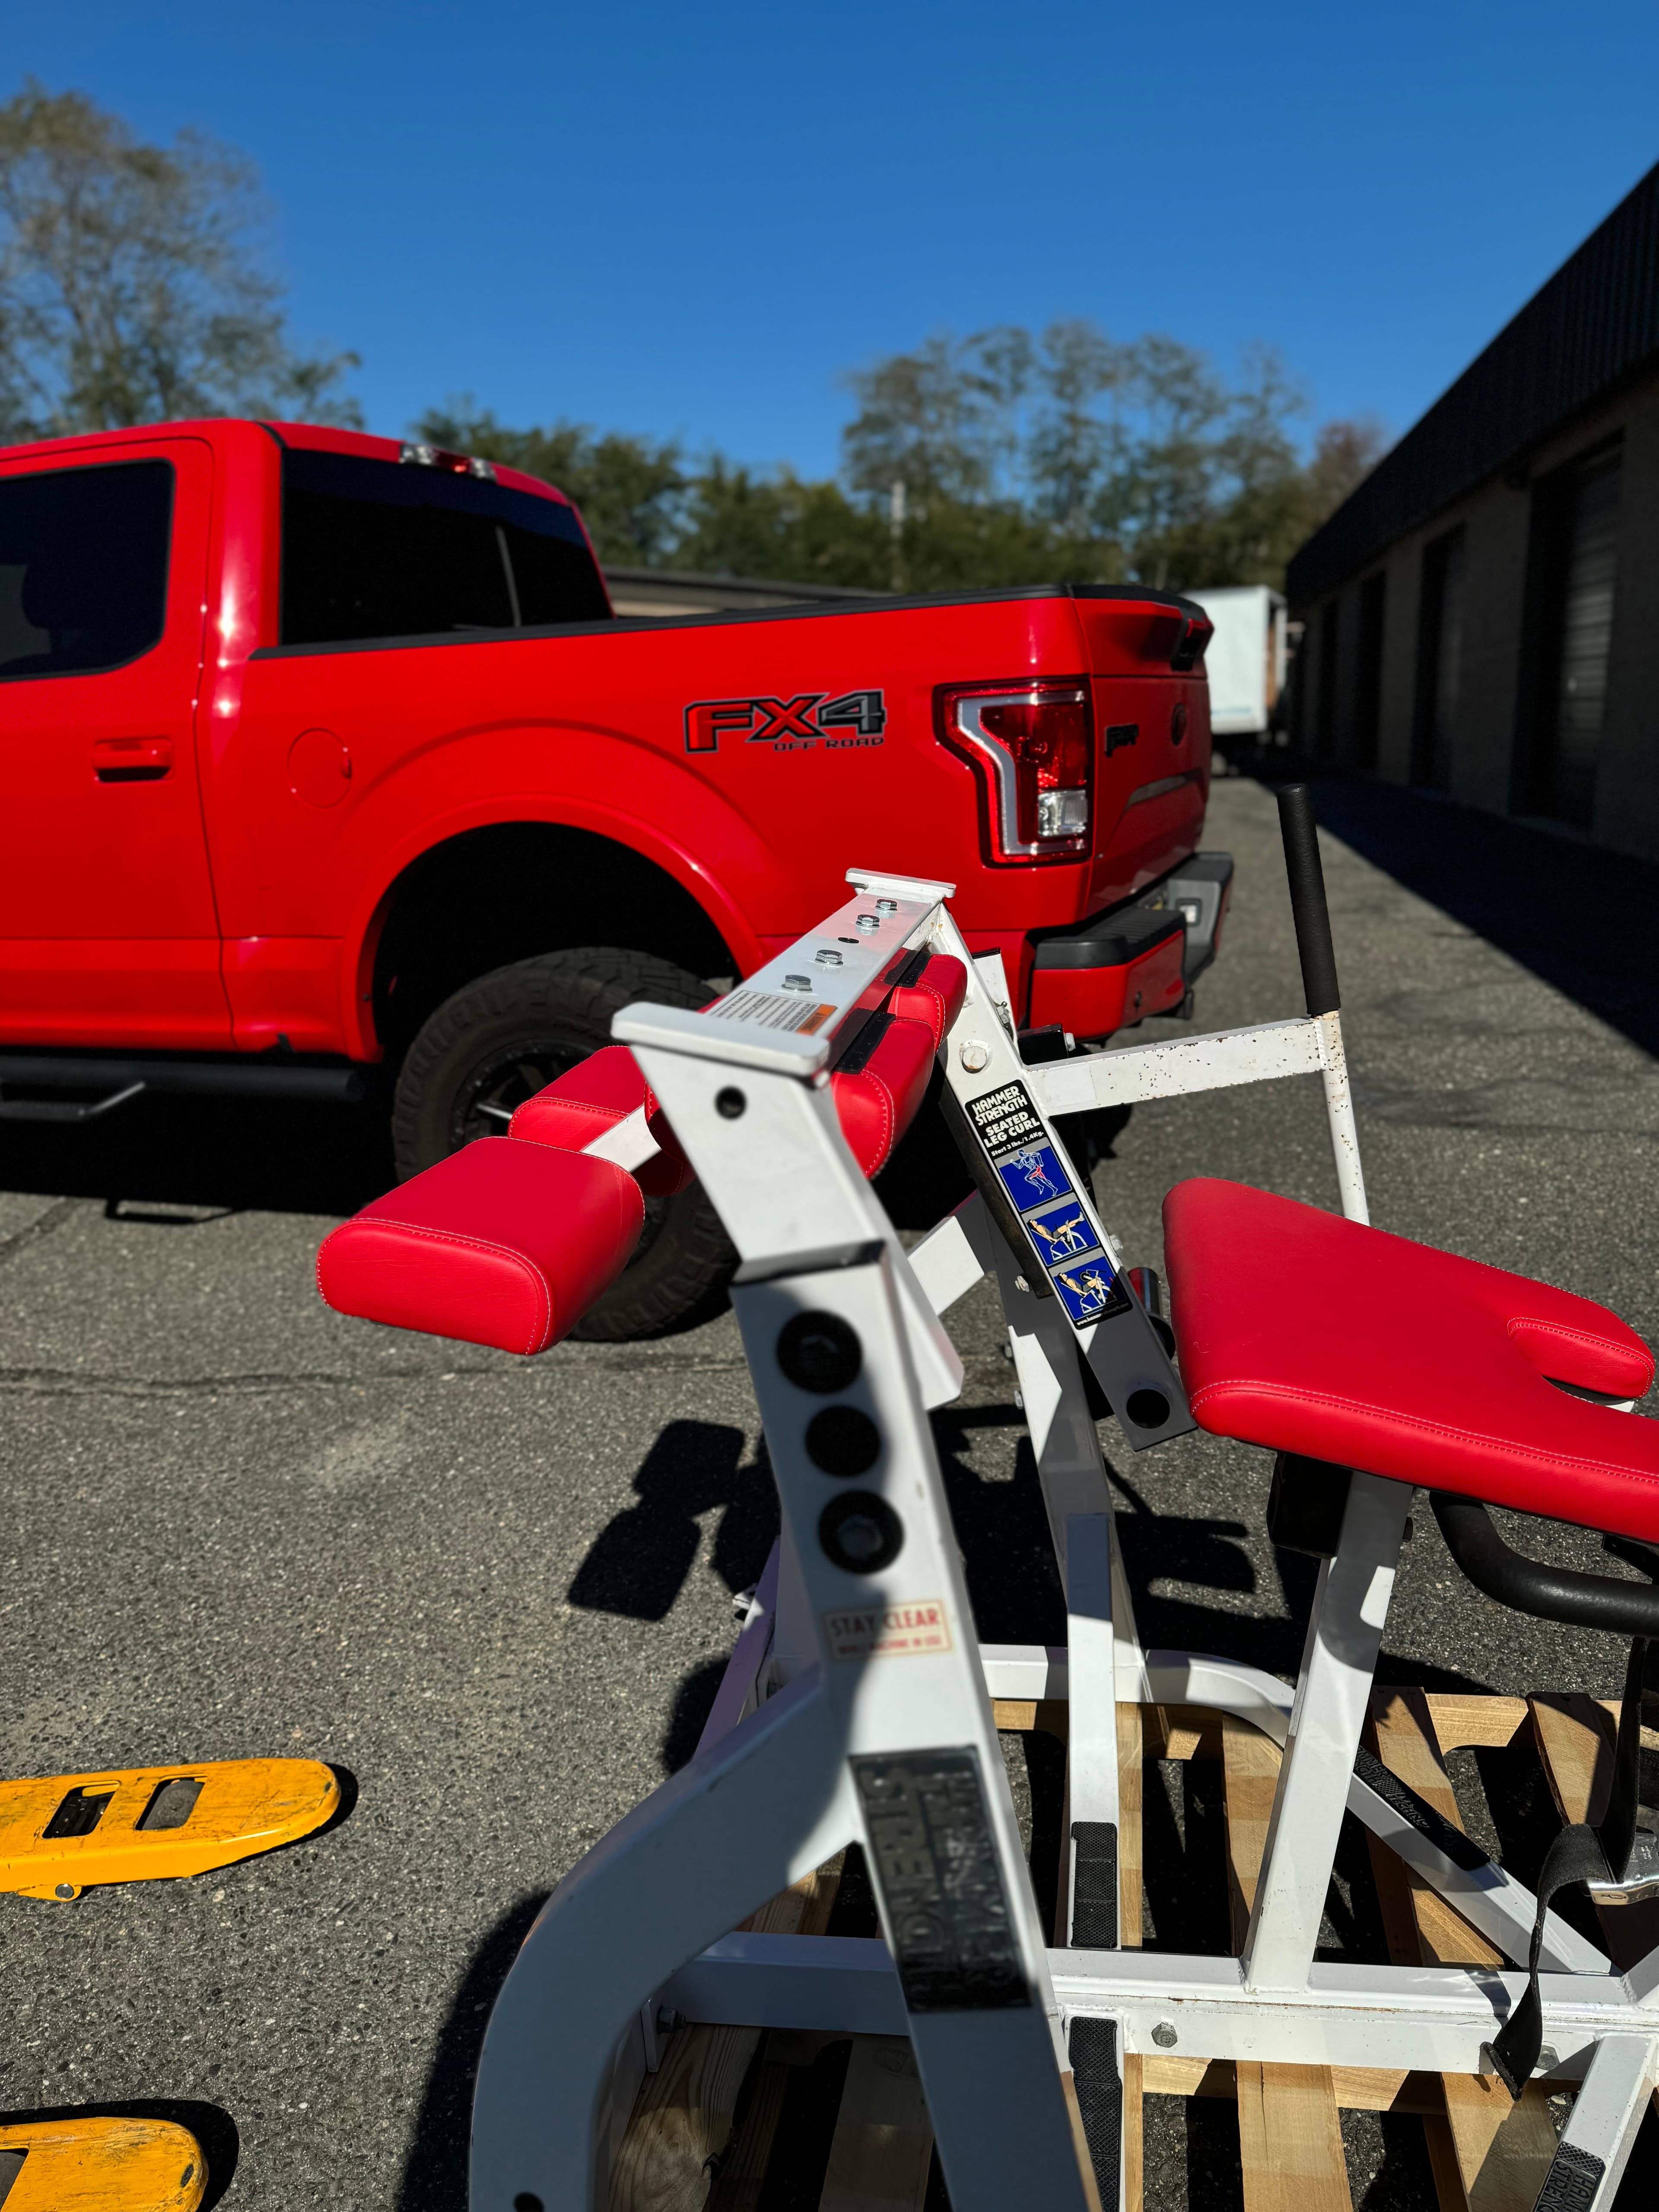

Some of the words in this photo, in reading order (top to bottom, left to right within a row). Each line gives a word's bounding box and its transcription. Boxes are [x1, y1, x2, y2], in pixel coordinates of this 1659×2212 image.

[683, 689, 887, 753] FX4
[773, 741, 816, 752] OFF
[825, 737, 884, 749] ROAD
[972, 1086, 1020, 1116] HAMMER
[975, 1094, 1028, 1126] STRENGTH
[983, 1131, 1007, 1148] LEG
[1008, 1118, 1040, 1136] CURL
[985, 1112, 1028, 1136] SEATED
[991, 1146, 1007, 1156] Start
[830, 1613, 875, 1637] STAY
[884, 1608, 939, 1630] CLEAR
